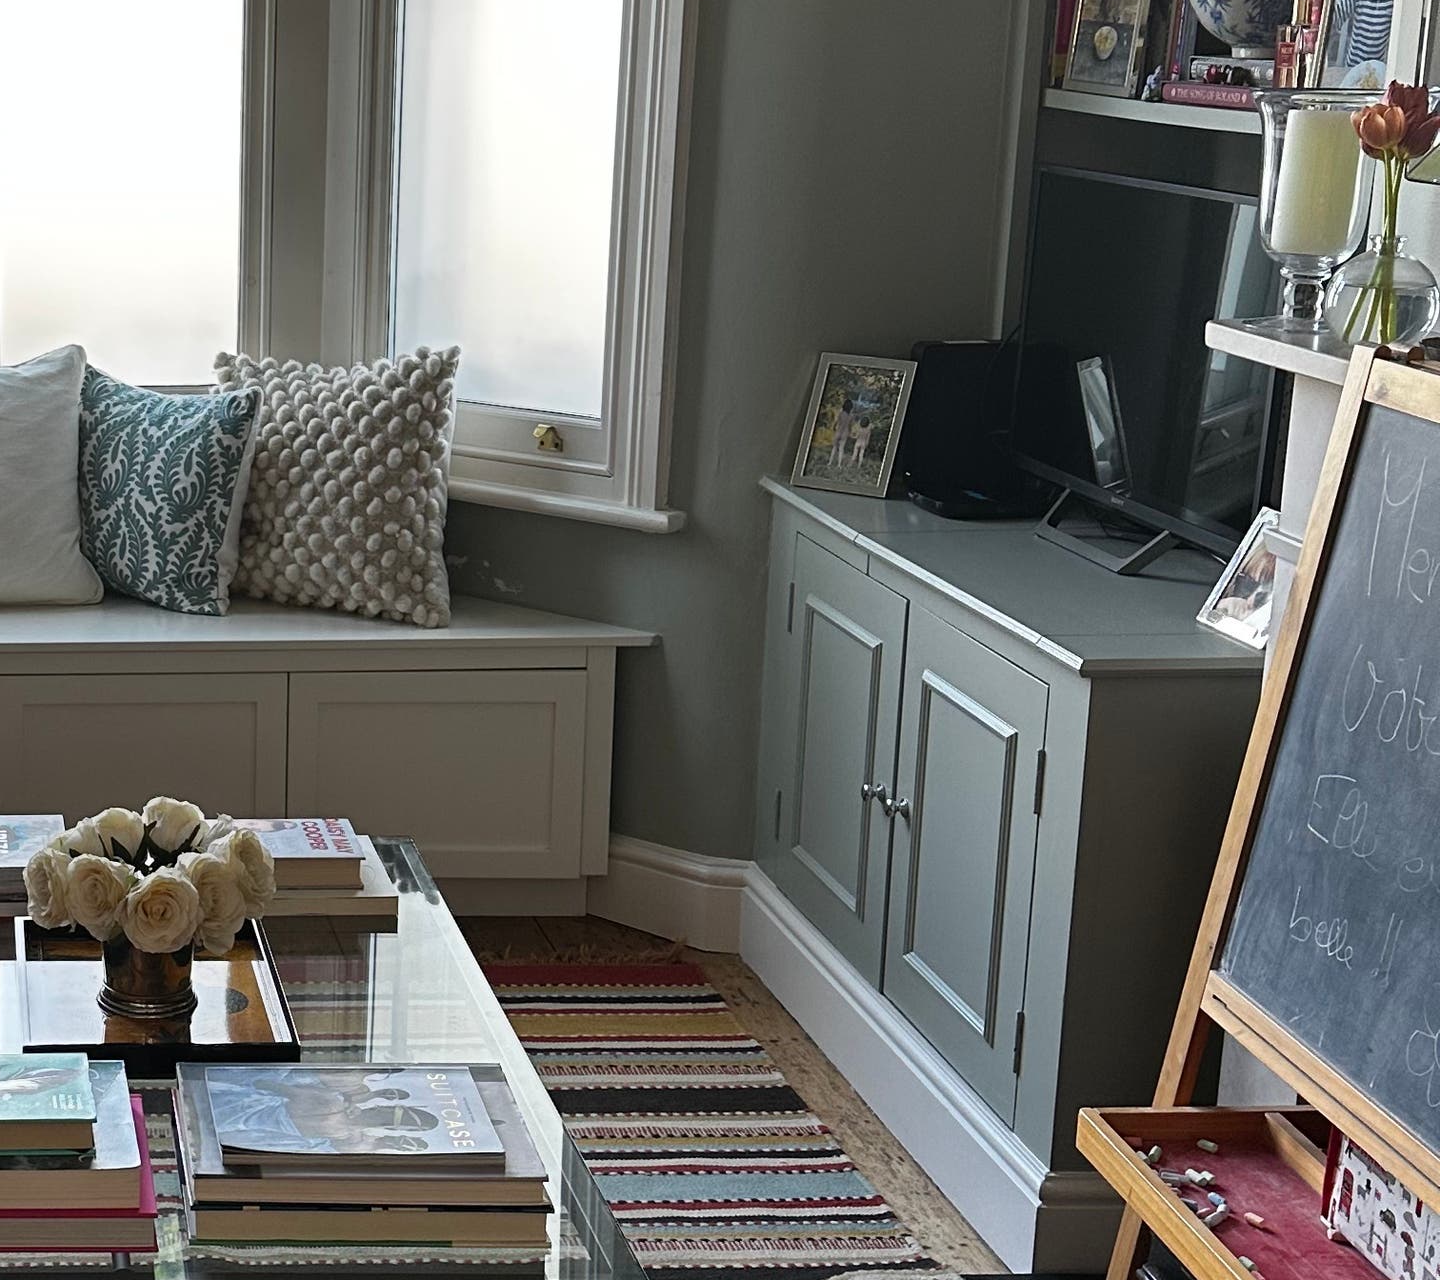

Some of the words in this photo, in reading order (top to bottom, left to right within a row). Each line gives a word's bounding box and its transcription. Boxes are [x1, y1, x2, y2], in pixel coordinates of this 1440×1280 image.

[301, 821, 328, 850] COOPER
[332, 838, 354, 854] MAY
[426, 1072, 476, 1148] SUITCASE
